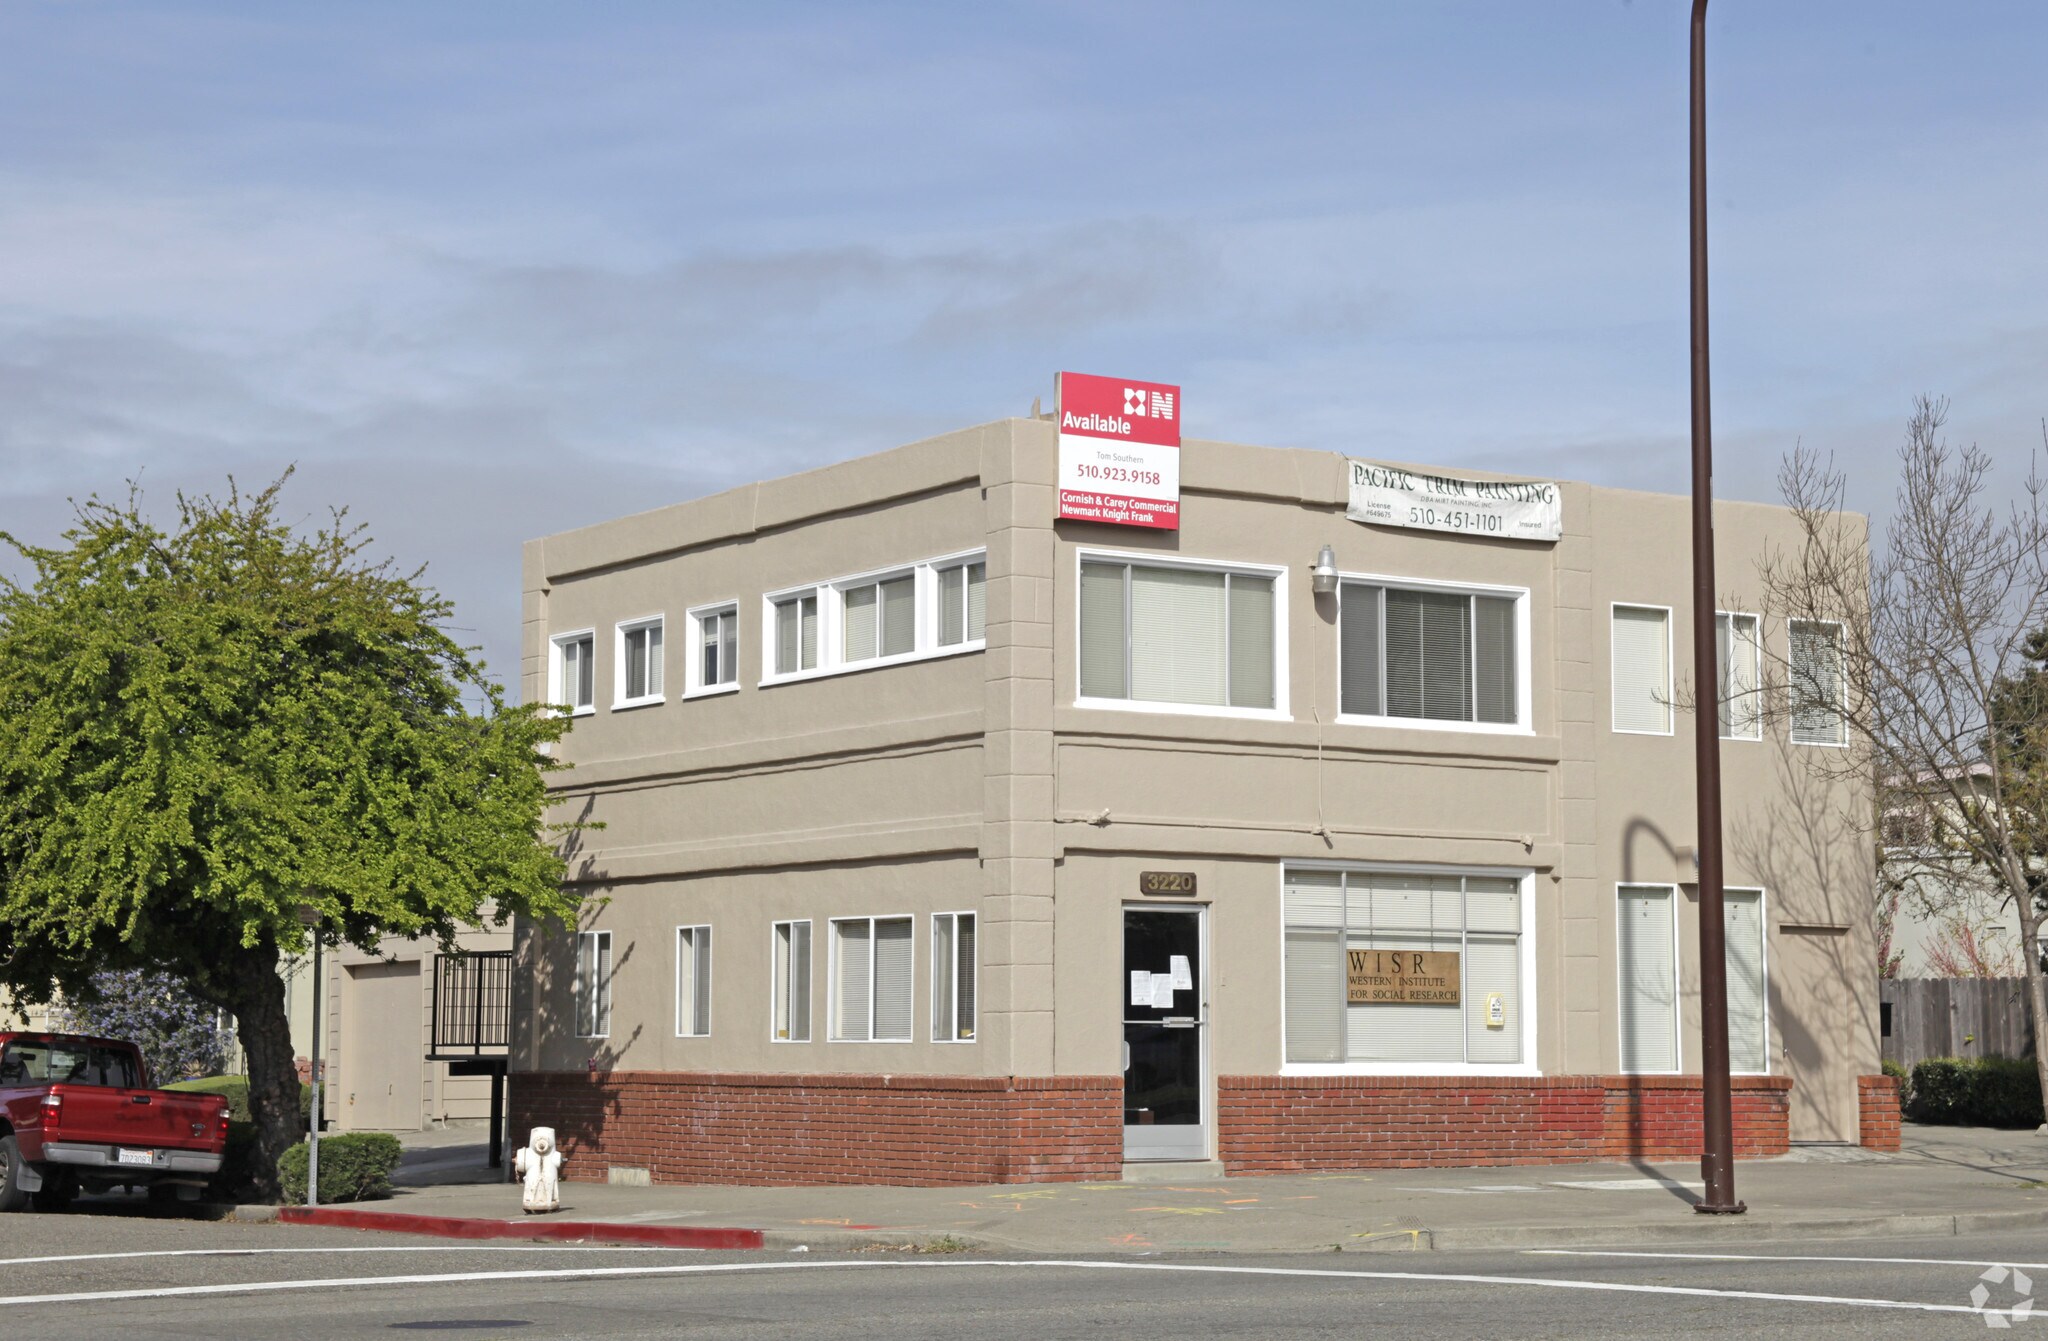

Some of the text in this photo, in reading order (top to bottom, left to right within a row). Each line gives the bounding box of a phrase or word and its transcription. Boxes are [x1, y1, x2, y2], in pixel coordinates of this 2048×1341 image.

[1063, 411, 1131, 435] Available
[1096, 451, 1144, 464] Tom Southern
[1077, 464, 1160, 485] 510.923.9158
[1353, 464, 1554, 505] PACIFIC TRIM PAINTING
[1062, 492, 1176, 514] Cornish & Carey Commercial
[1367, 501, 1391, 510] License
[1062, 504, 1154, 523] Newmark Knight Frank
[1410, 507, 1502, 532] 510-451-1101
[1519, 520, 1542, 529] Insured
[1148, 874, 1192, 891] 3220
[1349, 976, 1446, 987] WESTERN INSTITUTE
[1350, 989, 1457, 1000] FOR SOCIAL RESEARCH
